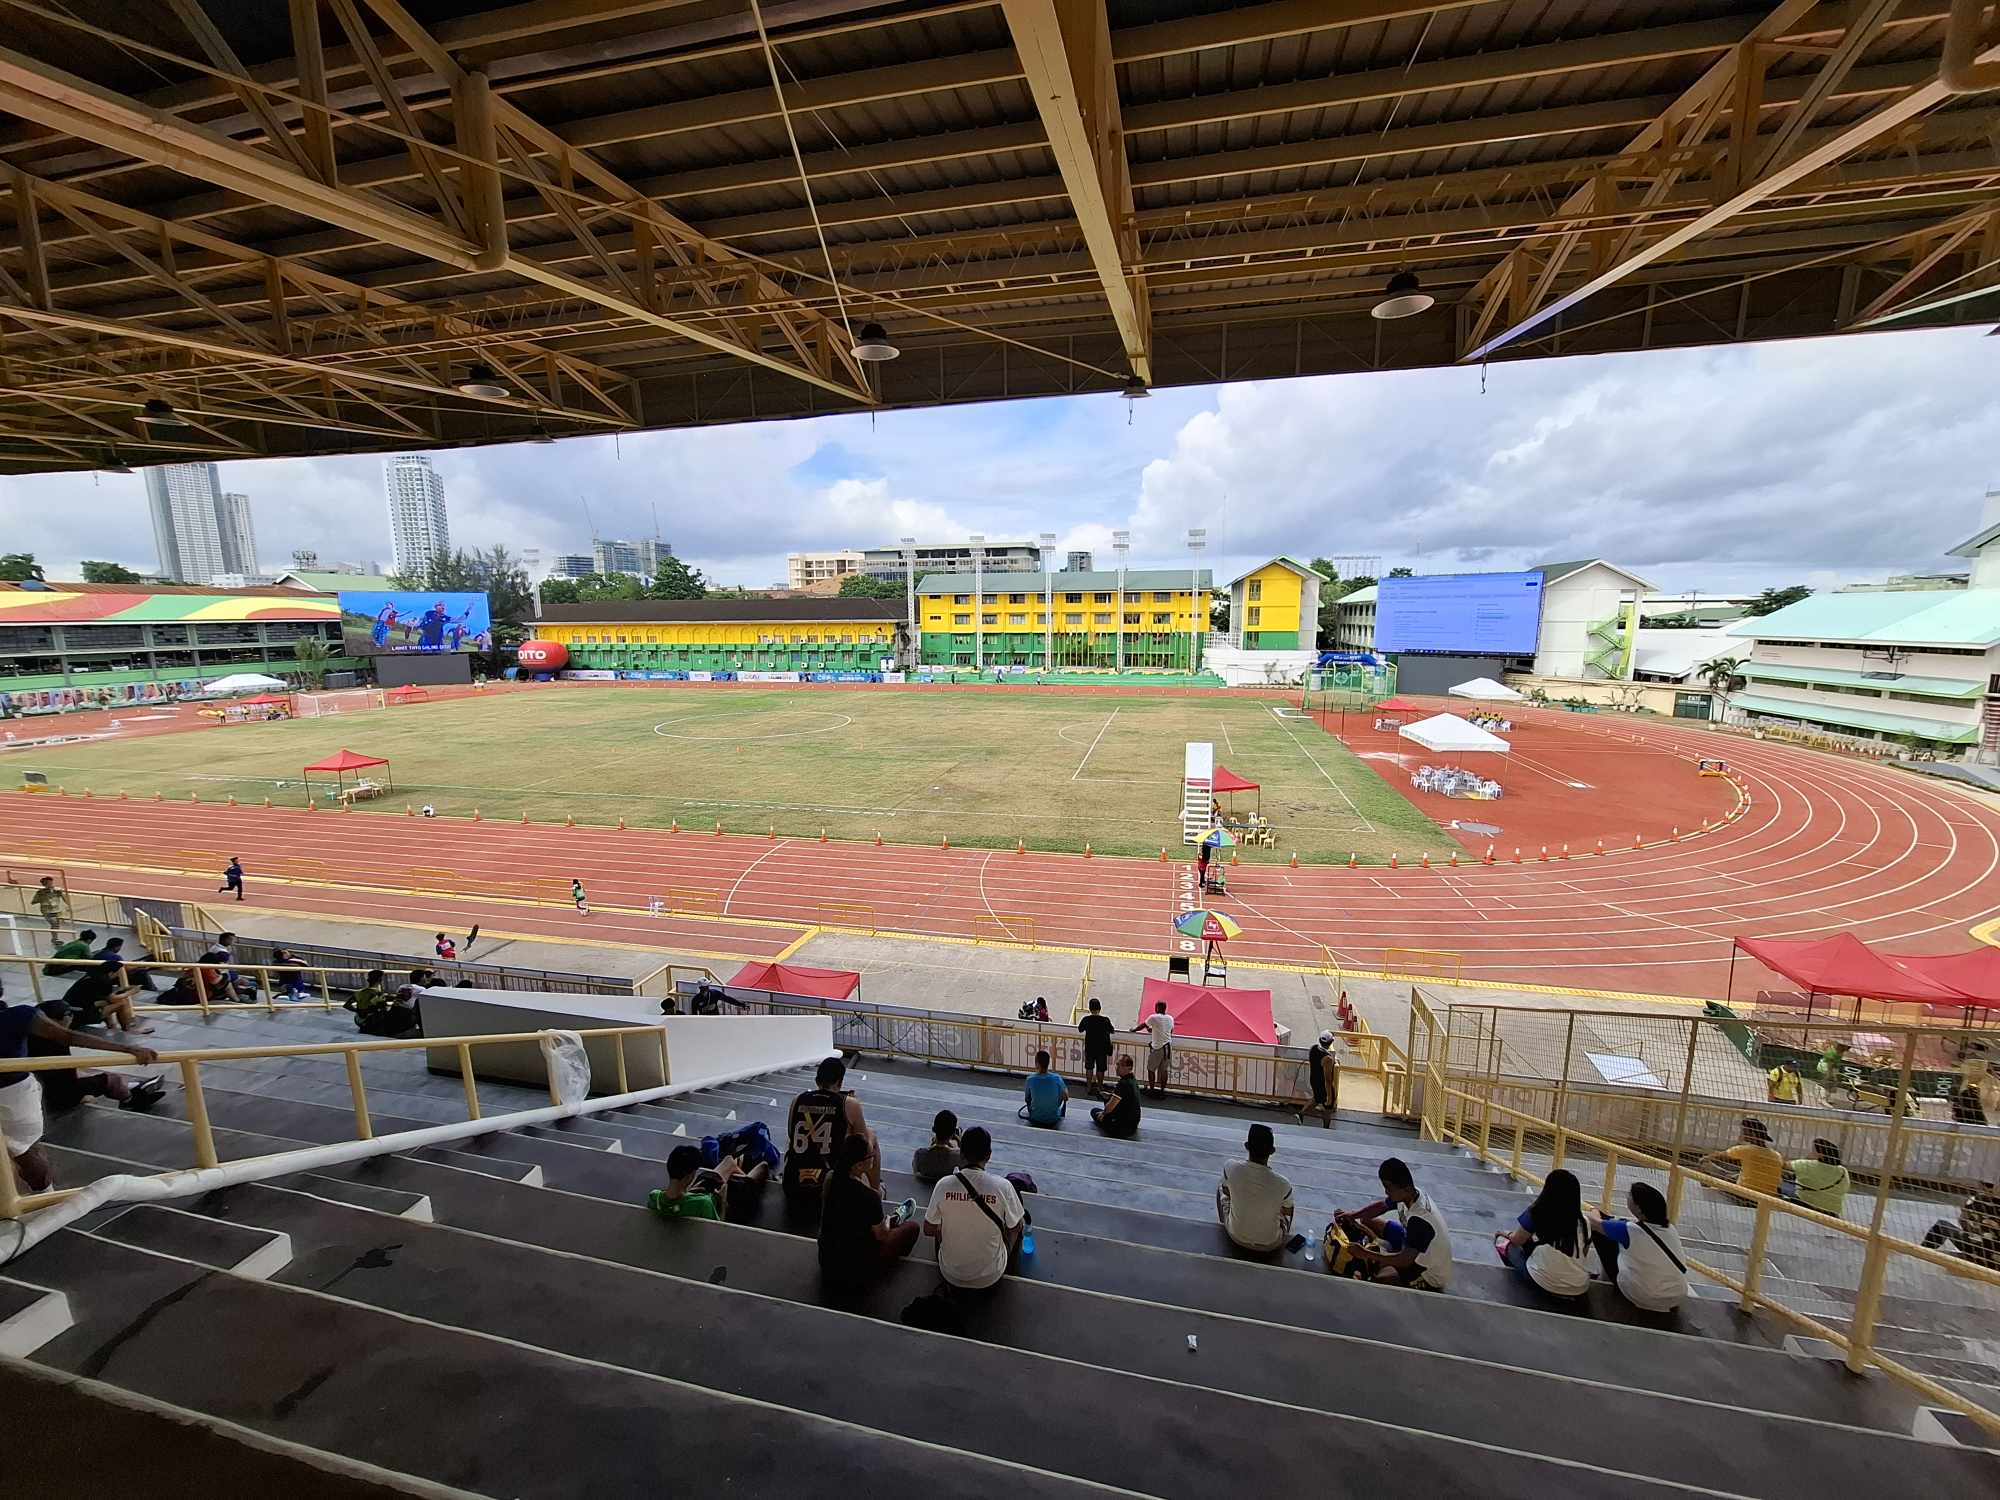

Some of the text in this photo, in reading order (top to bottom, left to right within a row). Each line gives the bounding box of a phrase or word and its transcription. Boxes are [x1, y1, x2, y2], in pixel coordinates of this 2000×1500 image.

[518, 650, 547, 659] DITO
[1180, 902, 1195, 911] 5
[1179, 940, 1196, 951] 8
[793, 1120, 832, 1154] 64
